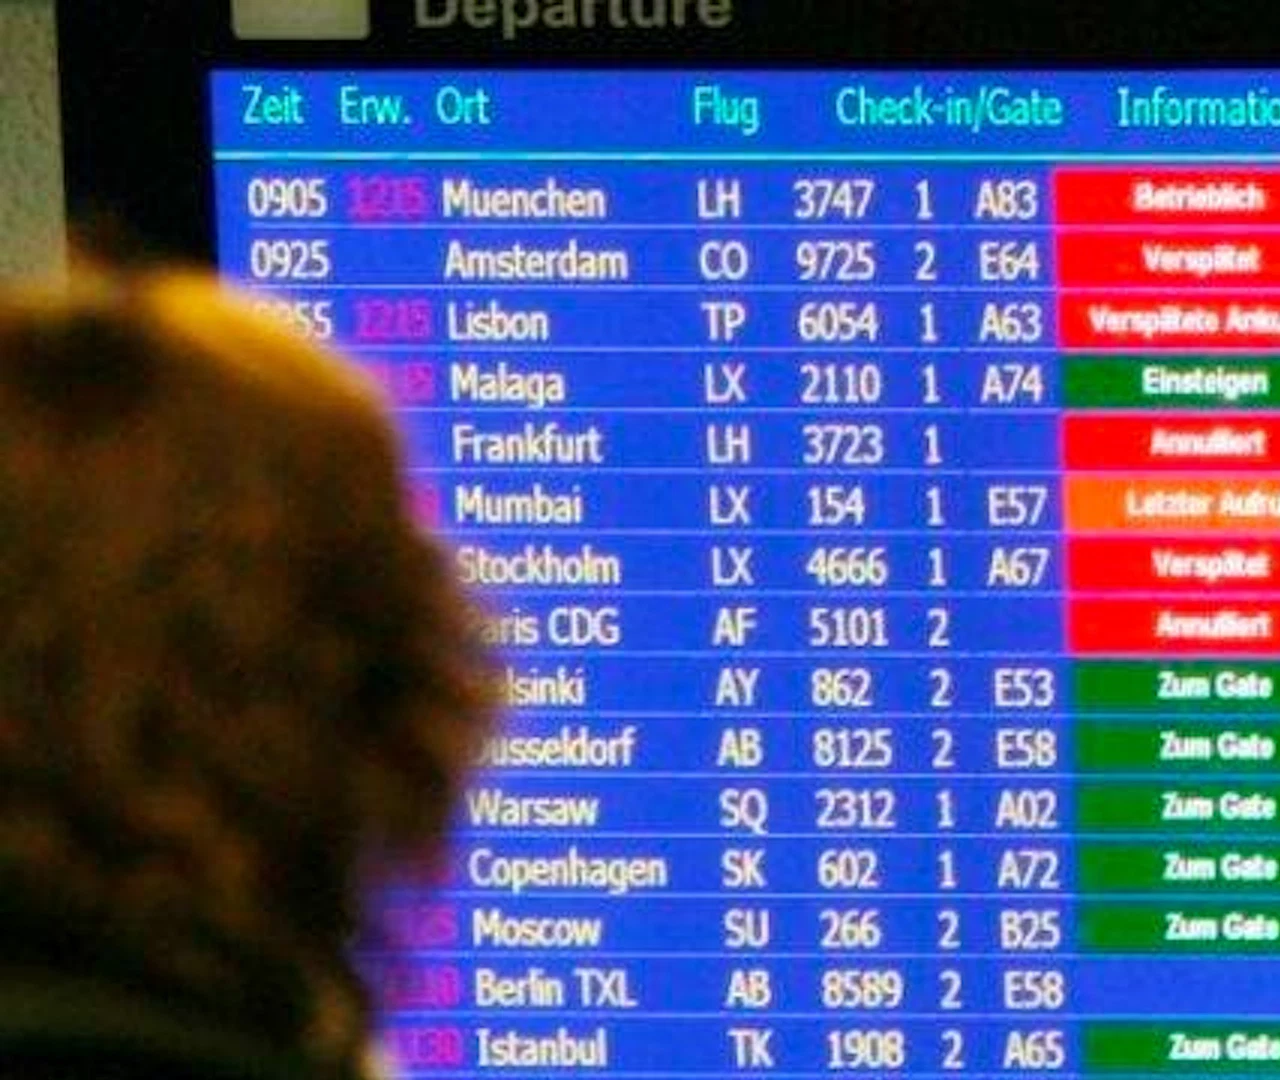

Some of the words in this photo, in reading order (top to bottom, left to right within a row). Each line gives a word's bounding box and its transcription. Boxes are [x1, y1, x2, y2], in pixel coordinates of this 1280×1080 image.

[243, 85, 304, 124] Zeit
[340, 86, 410, 124] Erw.
[436, 86, 490, 124] Ort
[693, 86, 760, 136] Flug
[836, 86, 1063, 132] Check-in/Gate
[248, 179, 327, 217] 0905
[443, 178, 605, 217] Muenchen
[698, 181, 739, 218] LH
[794, 180, 874, 218] 3747
[917, 181, 932, 219] 1
[976, 180, 1037, 219] A83
[1133, 182, 1265, 211] Betrieblich
[251, 240, 329, 279] 0925
[445, 240, 628, 279] Amsterdam
[700, 241, 748, 280] CO
[797, 241, 874, 280] 9725
[916, 242, 936, 280] 2
[980, 242, 1039, 280] E64
[451, 363, 565, 411] Malaga
[706, 364, 745, 402] LX
[801, 364, 881, 402] 2110
[924, 365, 939, 403] 1
[982, 364, 1042, 402] A74
[1143, 366, 1268, 400] Einsteigen
[455, 485, 582, 523] Mumbai
[710, 487, 749, 524] LX
[809, 486, 865, 524] 154
[927, 488, 943, 525] 1
[988, 487, 1047, 525] E57
[458, 546, 620, 584] Stockholm
[713, 548, 753, 585] LX
[806, 548, 887, 585] 4666
[930, 548, 945, 585] 1
[988, 548, 1048, 586] A67
[469, 848, 667, 896] Copenhagen
[722, 849, 765, 887] SK
[818, 849, 877, 888] 602
[940, 851, 955, 887] 1
[998, 851, 1059, 888] A72
[1163, 854, 1215, 881] Zum
[1221, 854, 1279, 881] Gate
[476, 969, 564, 1006] Berlin
[574, 969, 637, 1007] TXL
[726, 969, 771, 1008] AB
[822, 970, 903, 1008] 8589
[941, 970, 961, 1008] 2
[1004, 971, 1064, 1009] E58
